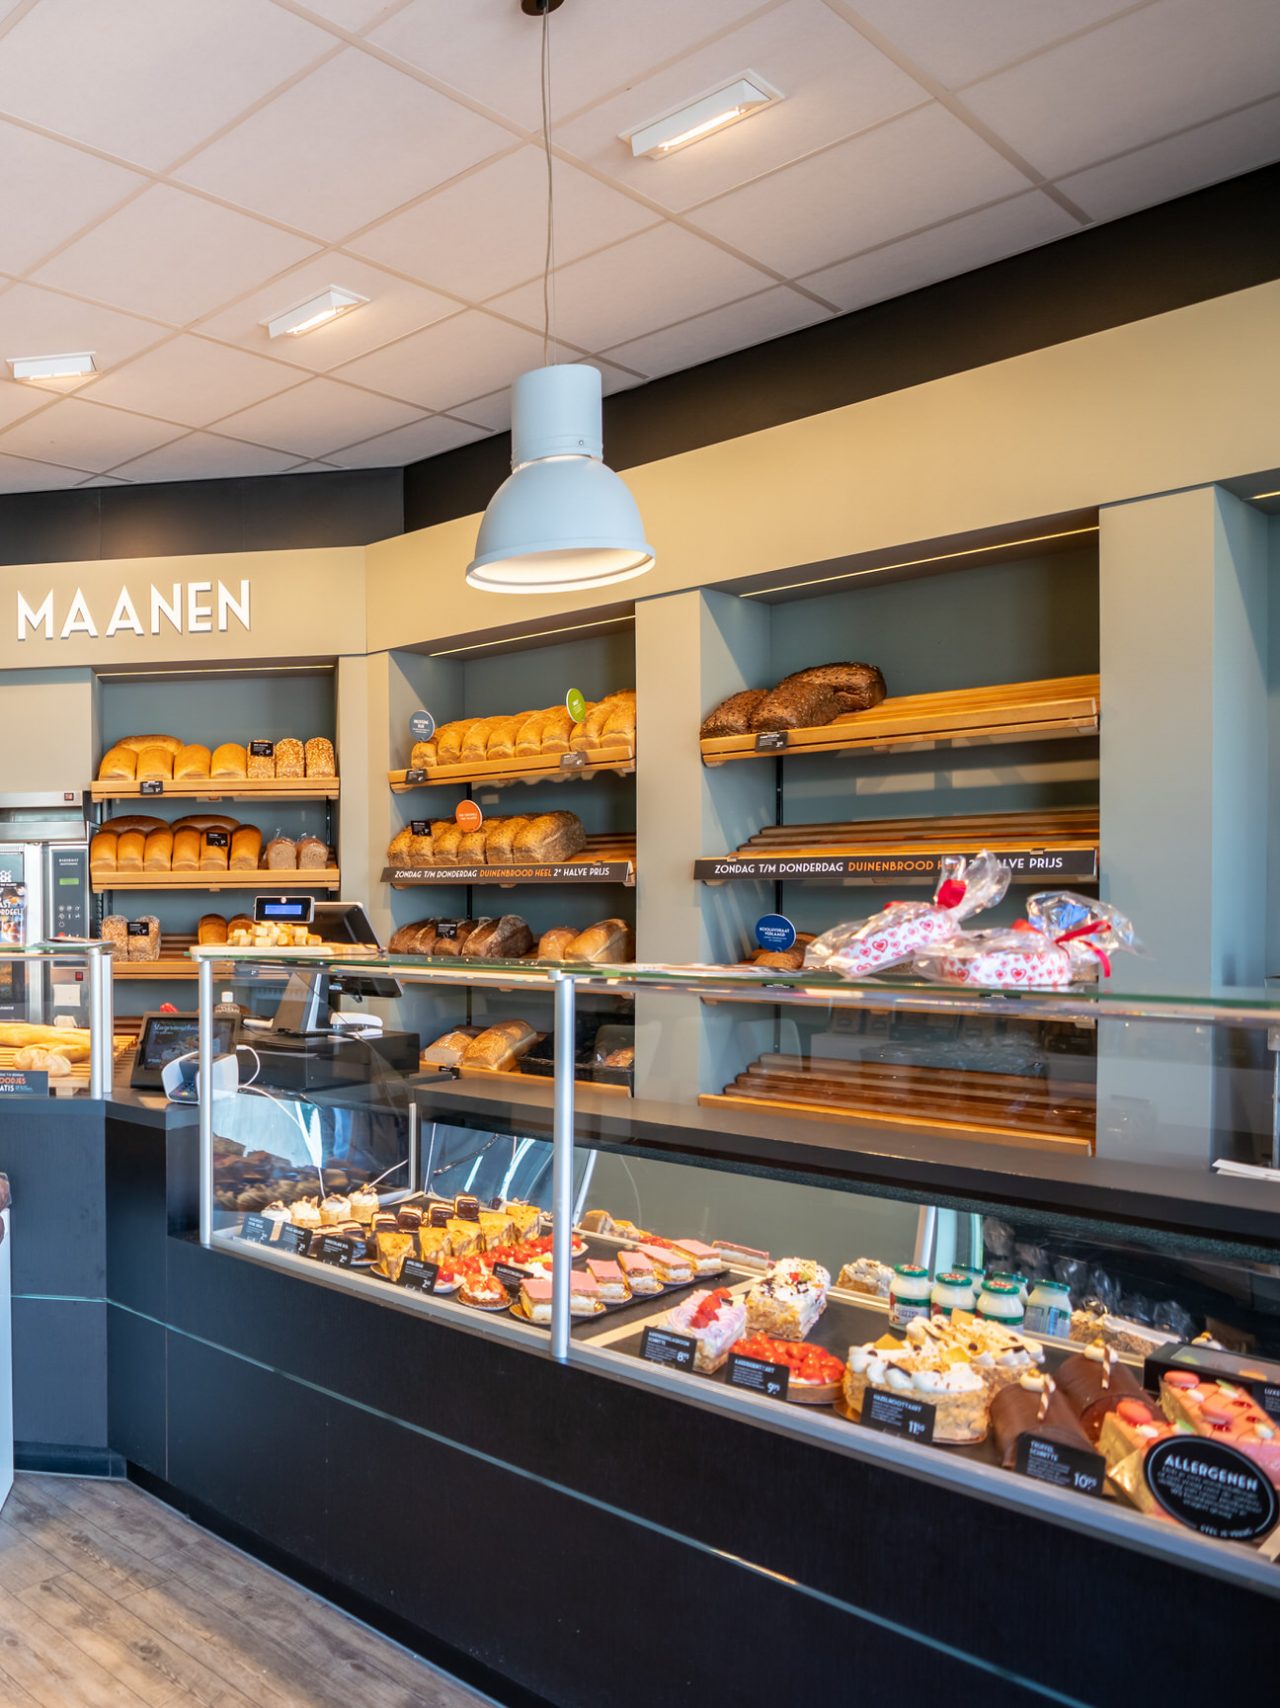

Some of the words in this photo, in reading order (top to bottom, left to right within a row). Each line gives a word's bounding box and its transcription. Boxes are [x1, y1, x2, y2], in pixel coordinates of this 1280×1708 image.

[17, 579, 251, 641] MAANEN
[395, 870, 422, 879] ZONDAG
[424, 870, 436, 878] T/M
[436, 869, 477, 878] DONDERDAG
[479, 868, 534, 878] DUINENBROOD
[534, 868, 552, 877] HEEL
[563, 867, 587, 877] HALVE
[589, 866, 610, 876] PRIJS
[715, 864, 755, 874] ZONDAG
[759, 863, 776, 873] T/M
[779, 862, 844, 872] DONDERDAG
[848, 860, 934, 872] DUINENBROOD
[997, 858, 1024, 869] ALVE
[1029, 857, 1063, 869] PRIJS
[1164, 1454, 1258, 1491] ALLERGENEN
